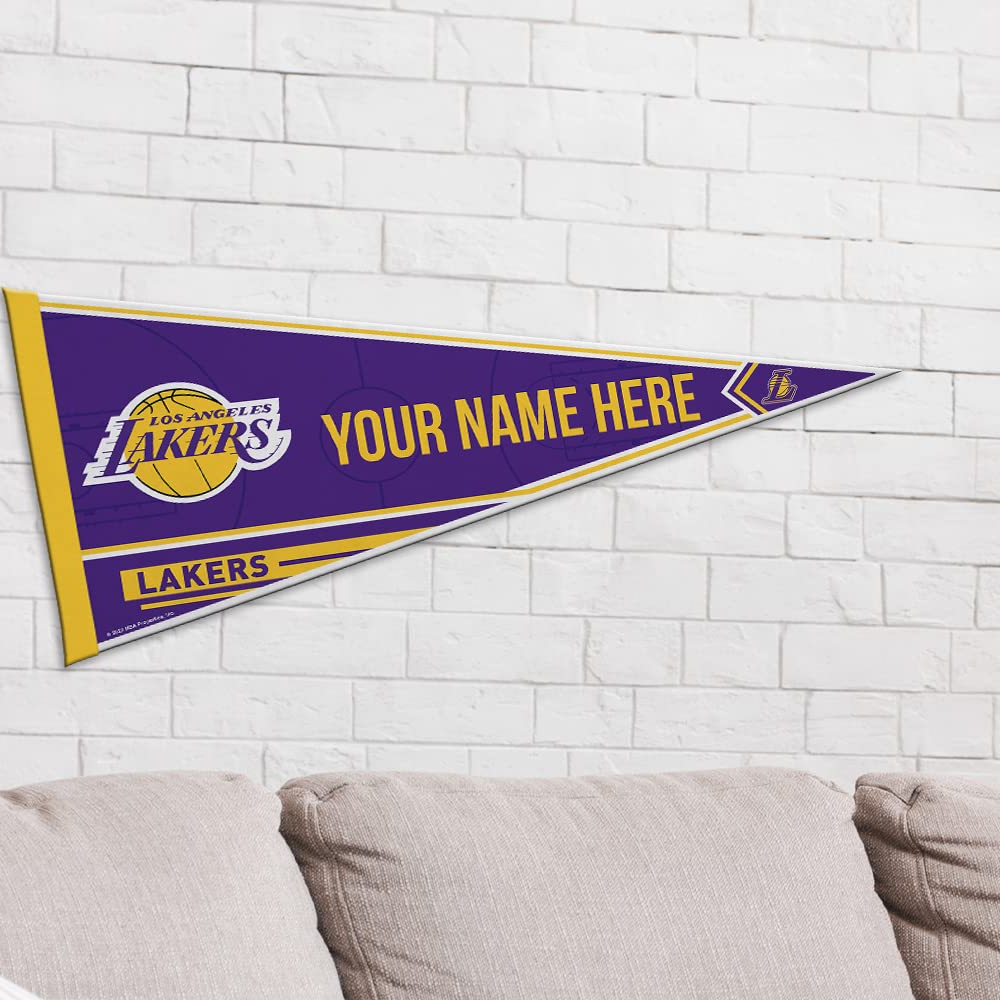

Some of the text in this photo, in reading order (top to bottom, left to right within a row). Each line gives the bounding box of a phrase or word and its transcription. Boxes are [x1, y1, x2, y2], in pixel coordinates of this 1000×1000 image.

[149, 403, 273, 426] LOS ANGELES
[320, 372, 702, 466] YOUR NAME HERE
[92, 417, 285, 478] LAKERS
[136, 554, 269, 595] LAKERS
